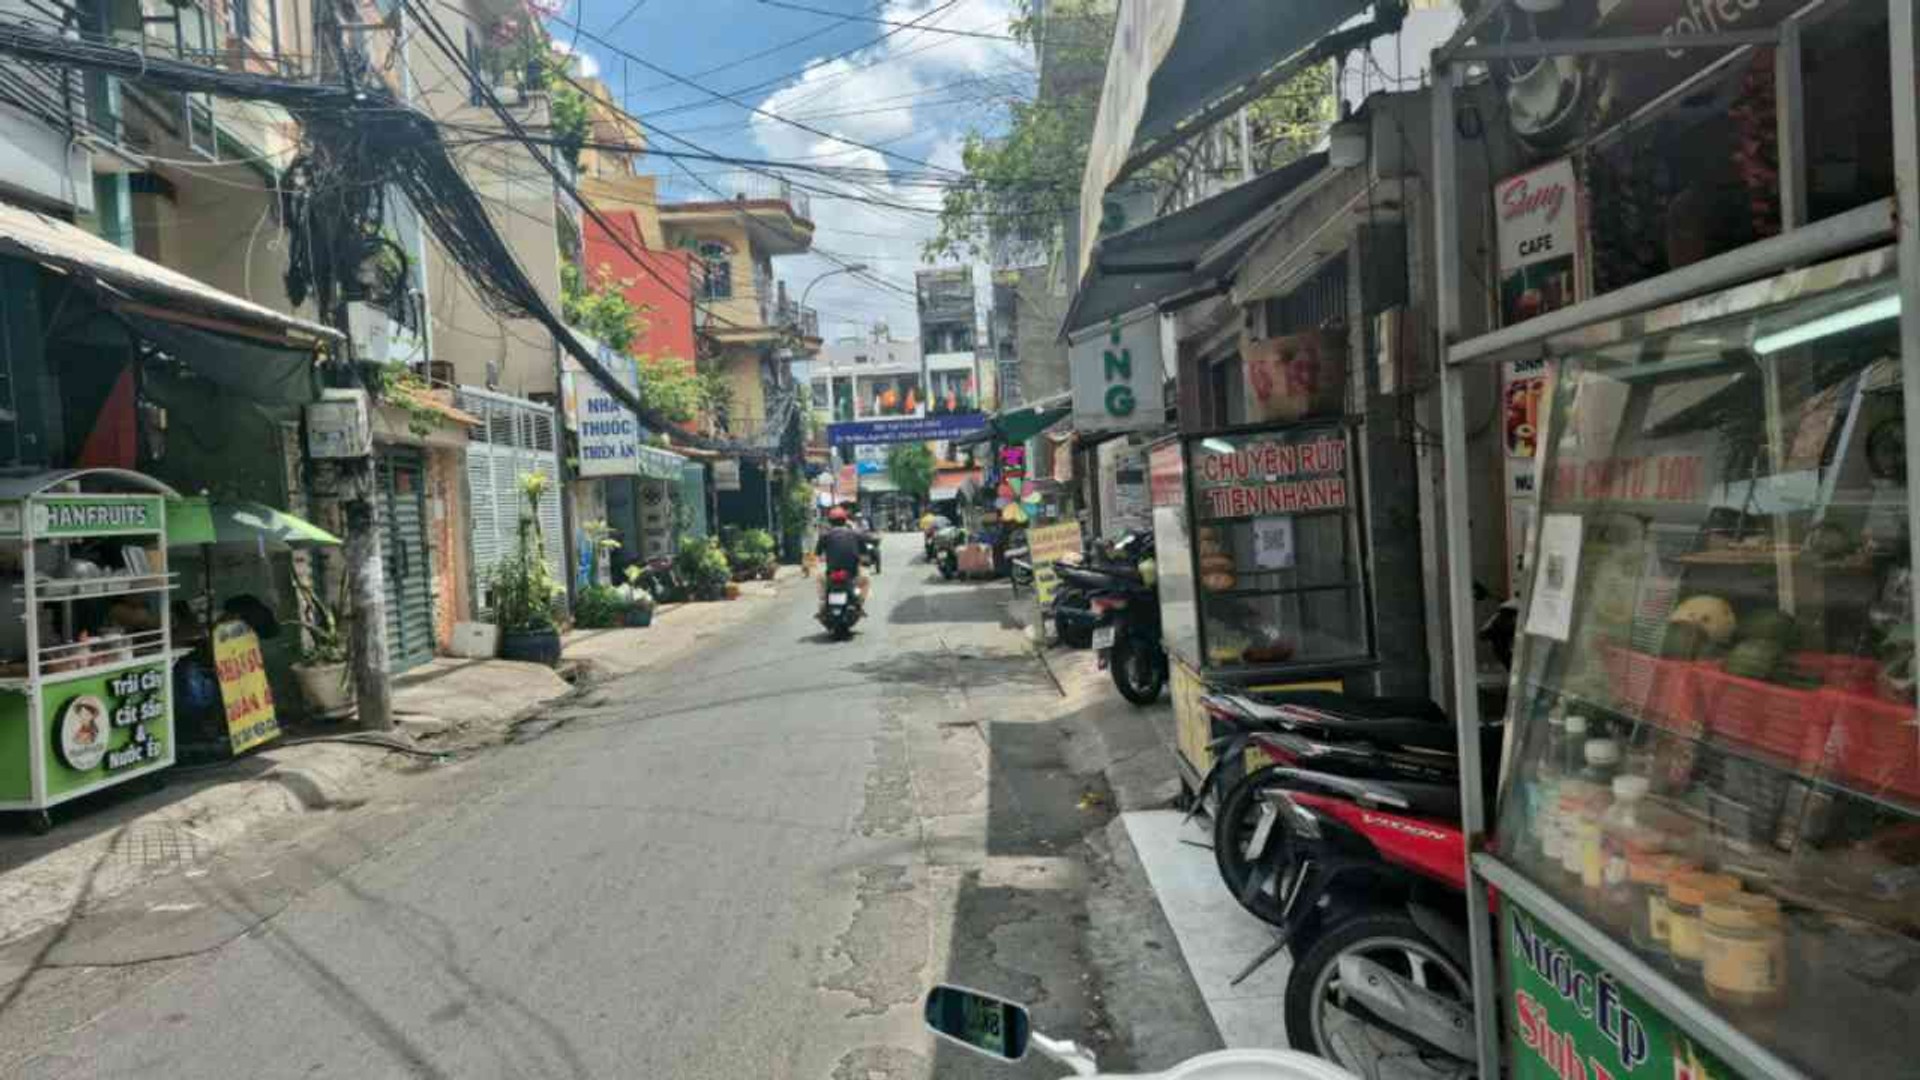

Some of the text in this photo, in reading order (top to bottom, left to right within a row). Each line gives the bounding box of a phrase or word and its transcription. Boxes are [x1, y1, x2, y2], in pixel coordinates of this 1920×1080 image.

[1264, 478, 1346, 514] NHANH
[1362, 812, 1447, 841] VISION
[1511, 907, 1648, 1071] Nước Ép
